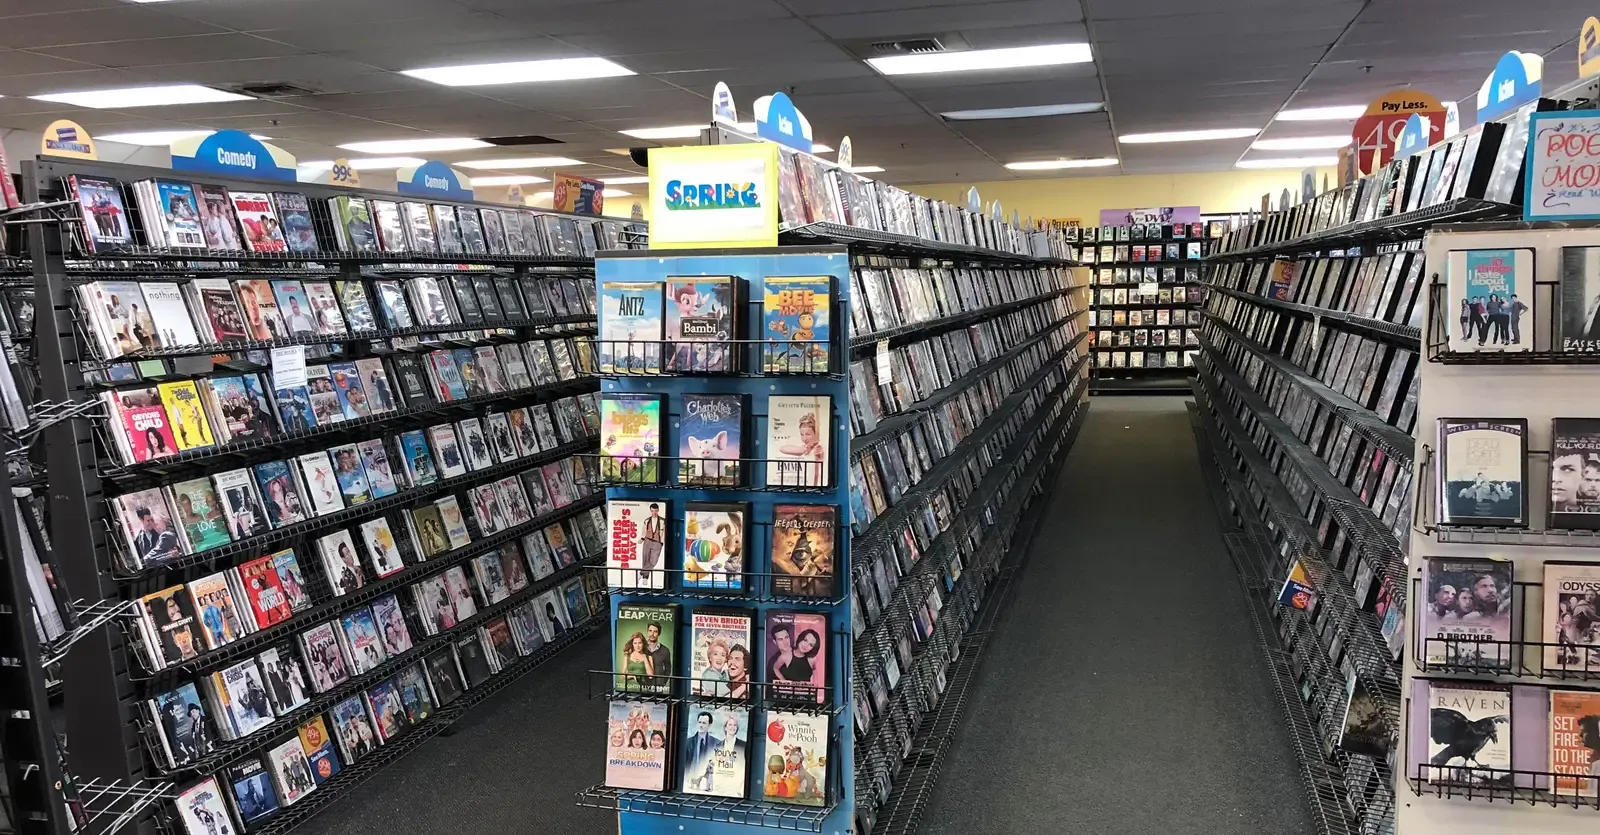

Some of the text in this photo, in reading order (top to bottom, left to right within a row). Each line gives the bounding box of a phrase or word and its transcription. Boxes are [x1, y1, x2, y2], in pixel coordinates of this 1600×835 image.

[1382, 101, 1428, 112] Pay Less.
[217, 147, 257, 169] Comedy
[424, 173, 449, 192] Comedy
[666, 179, 758, 207] SPRING
[1052, 219, 1080, 228] RELEASES
[1471, 275, 1506, 286] about
[1475, 269, 1501, 280] hate
[1488, 284, 1510, 295] you
[149, 291, 181, 301] nothing
[779, 289, 815, 306] BEE
[618, 293, 645, 317] ANTZ
[683, 322, 717, 334] Bambi
[687, 401, 731, 416] Charlotte's
[132, 411, 160, 421] OBVIOUS
[700, 411, 720, 423] Web
[134, 419, 163, 431] CHILD
[1448, 424, 1522, 436] WIDE SCREEN
[196, 521, 217, 533] LOVE
[774, 519, 802, 529] JEEPERS
[613, 520, 621, 560] FERRIS
[621, 508, 631, 569] BUELLER'S
[256, 591, 285, 612] WORLD
[618, 610, 673, 621] LEAP YEAR
[720, 617, 747, 625] BRIDES
[226, 672, 244, 684] CRISIS
[1438, 696, 1505, 712] RAVEN
[788, 724, 816, 734] Winnie
[1554, 716, 1575, 731] SET
[796, 733, 818, 743] Pooh
[1554, 732, 1579, 747] FIRE
[616, 751, 655, 761] SPRING
[713, 748, 737, 759] You've
[1554, 748, 1592, 763] TO THE
[610, 759, 662, 769] BREAKDOWN
[718, 760, 734, 769] Mail
